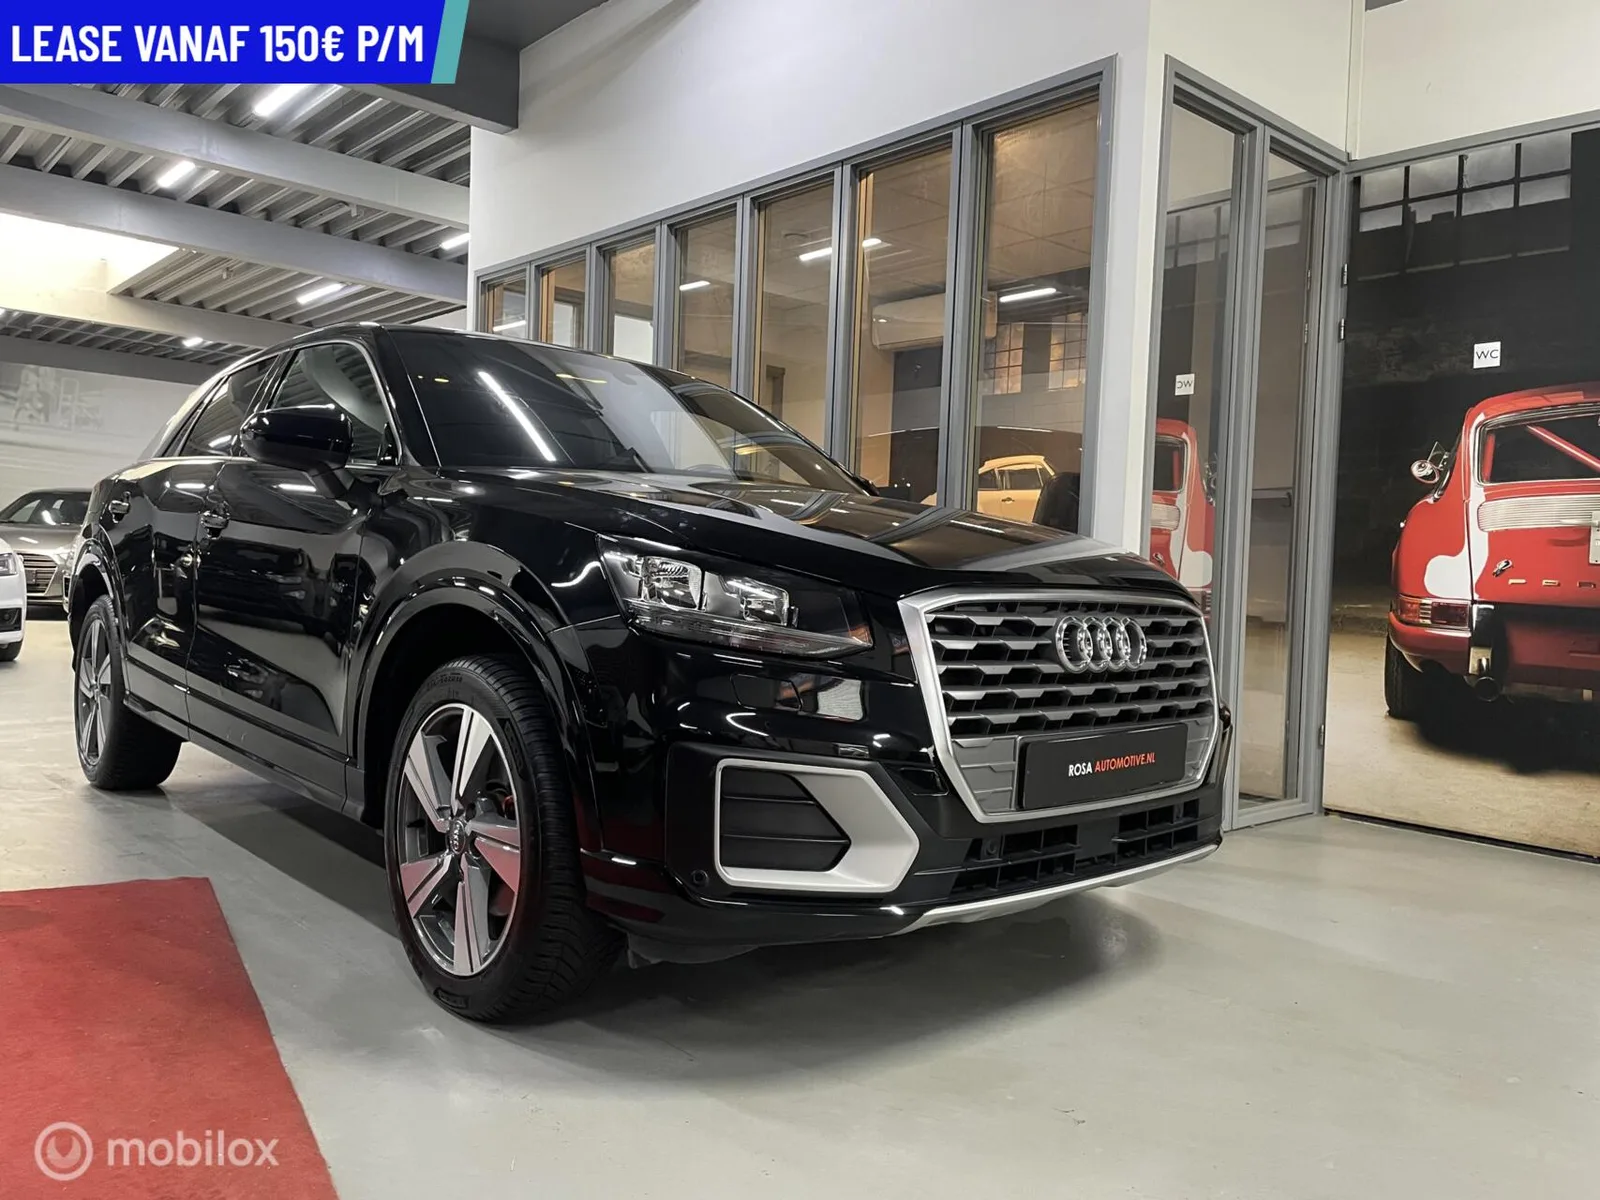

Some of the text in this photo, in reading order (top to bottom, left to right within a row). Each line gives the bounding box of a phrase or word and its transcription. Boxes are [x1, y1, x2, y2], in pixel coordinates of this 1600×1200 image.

[1475, 349, 1499, 360] WC
[1068, 752, 1156, 777] ROSA AUTOMOTIVE.NL
